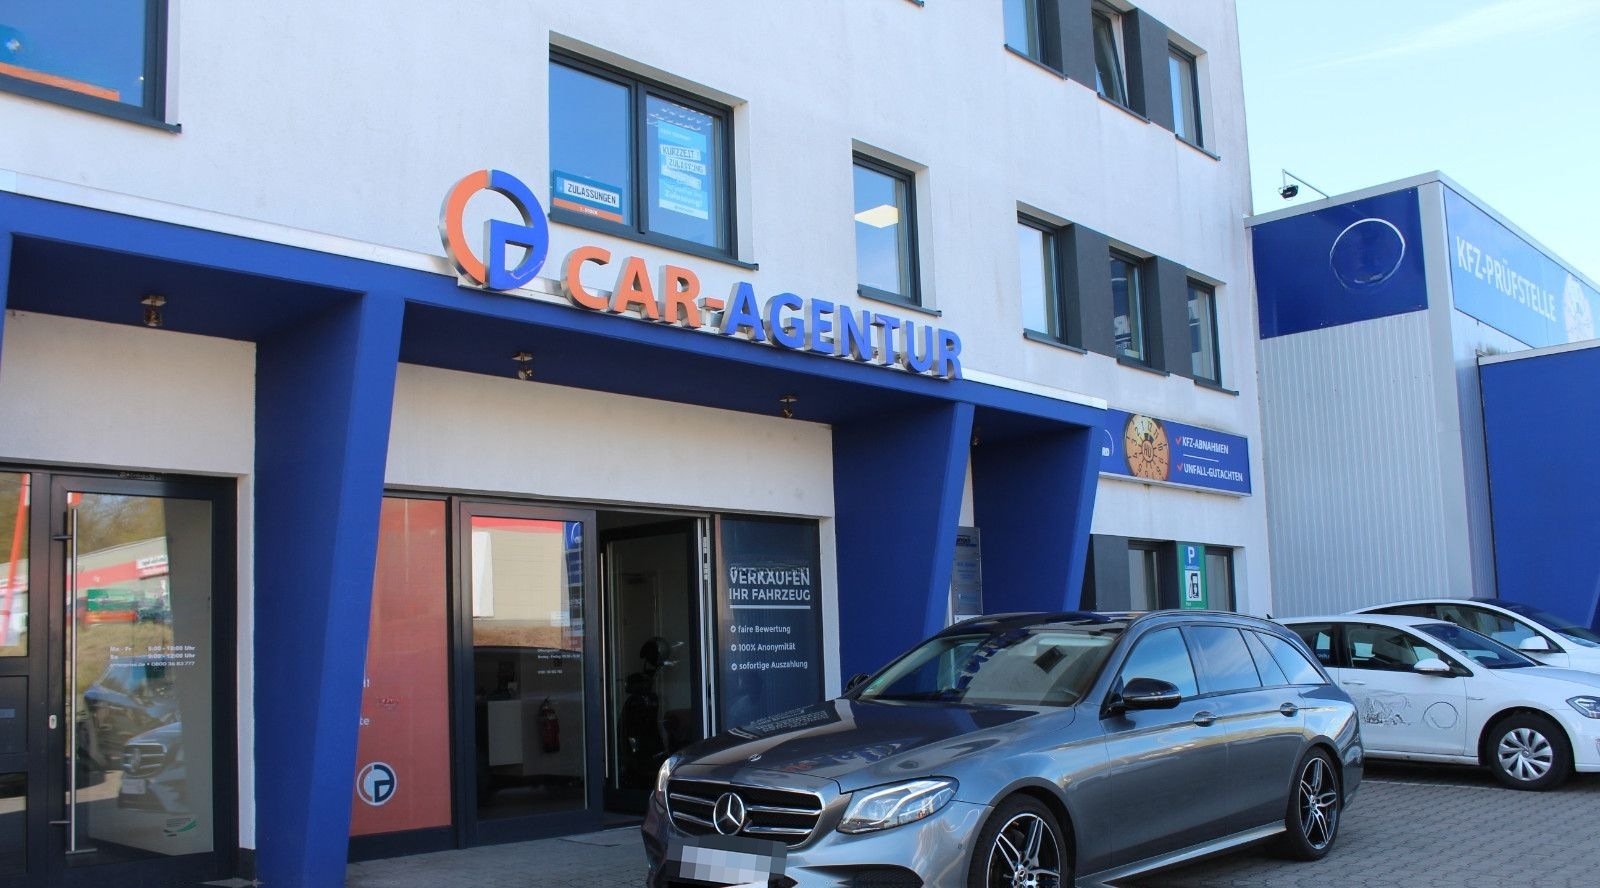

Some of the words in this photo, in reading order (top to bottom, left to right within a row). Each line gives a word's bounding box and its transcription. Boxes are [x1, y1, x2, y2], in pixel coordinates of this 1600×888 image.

[568, 183, 616, 205] ZULASSUNGEN
[1456, 235, 1557, 322] KFZ-PRÜFSTELLE
[561, 245, 962, 379] CAR-AGENTUR
[1182, 436, 1229, 455] KFZ-ABNAHMEN
[1184, 463, 1244, 482] UNFALL-GUTACHTEN
[1187, 545, 1195, 564] P
[730, 566, 810, 586] VERKAUFEN
[729, 588, 748, 600] IHR
[752, 588, 811, 601] FAHRZEUG
[738, 625, 753, 633] faire
[755, 625, 791, 635] Bewertung
[738, 643, 756, 652] 100%
[757, 642, 796, 653] Anonymität
[739, 661, 770, 671] sofortige
[771, 660, 808, 670] Auszahlung
